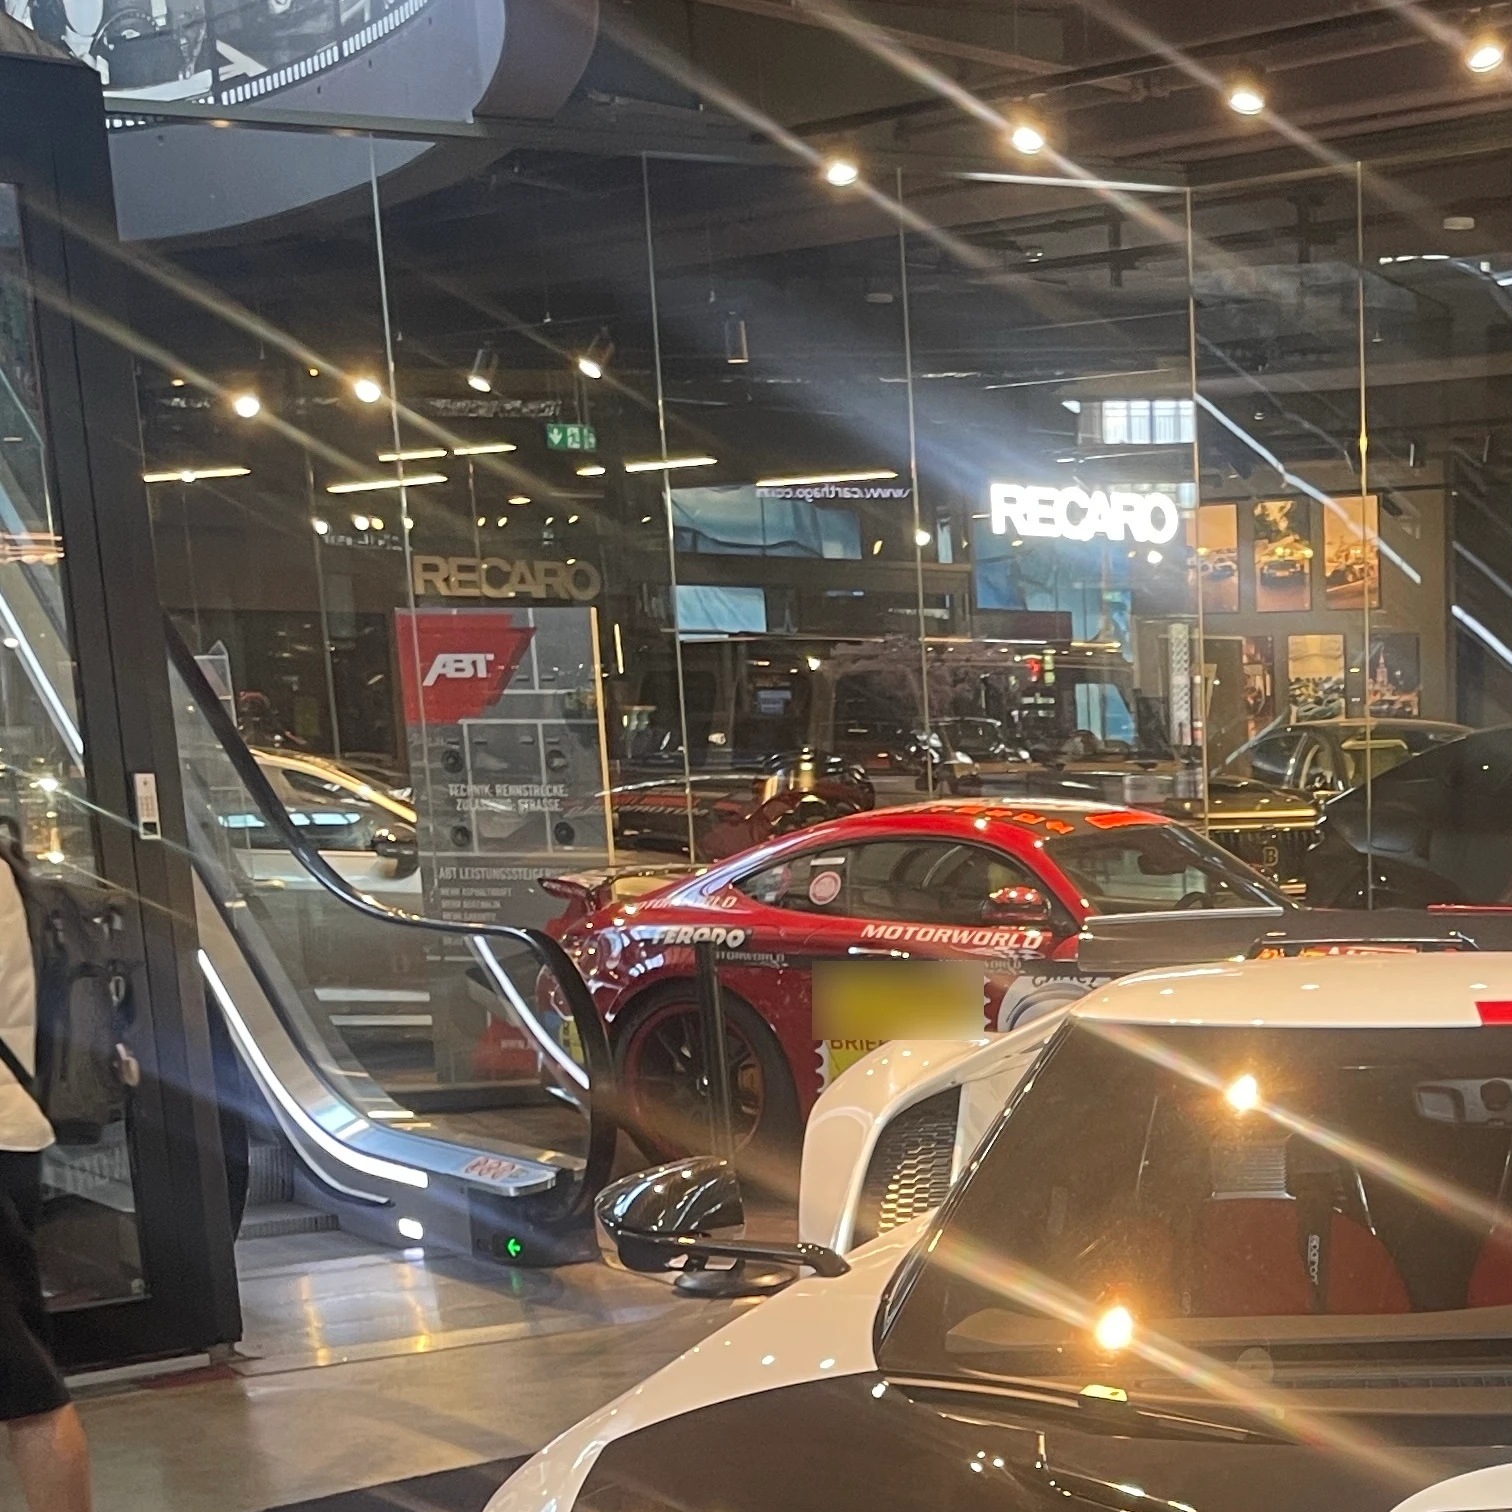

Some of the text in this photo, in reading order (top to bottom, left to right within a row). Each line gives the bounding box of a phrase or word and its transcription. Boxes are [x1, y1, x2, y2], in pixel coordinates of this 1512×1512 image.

[990, 483, 1179, 544] RECARO
[413, 555, 601, 601] RECARO
[423, 653, 495, 686] ABT
[652, 927, 745, 948] FERODO
[861, 924, 1043, 949] MOTORWORLD
